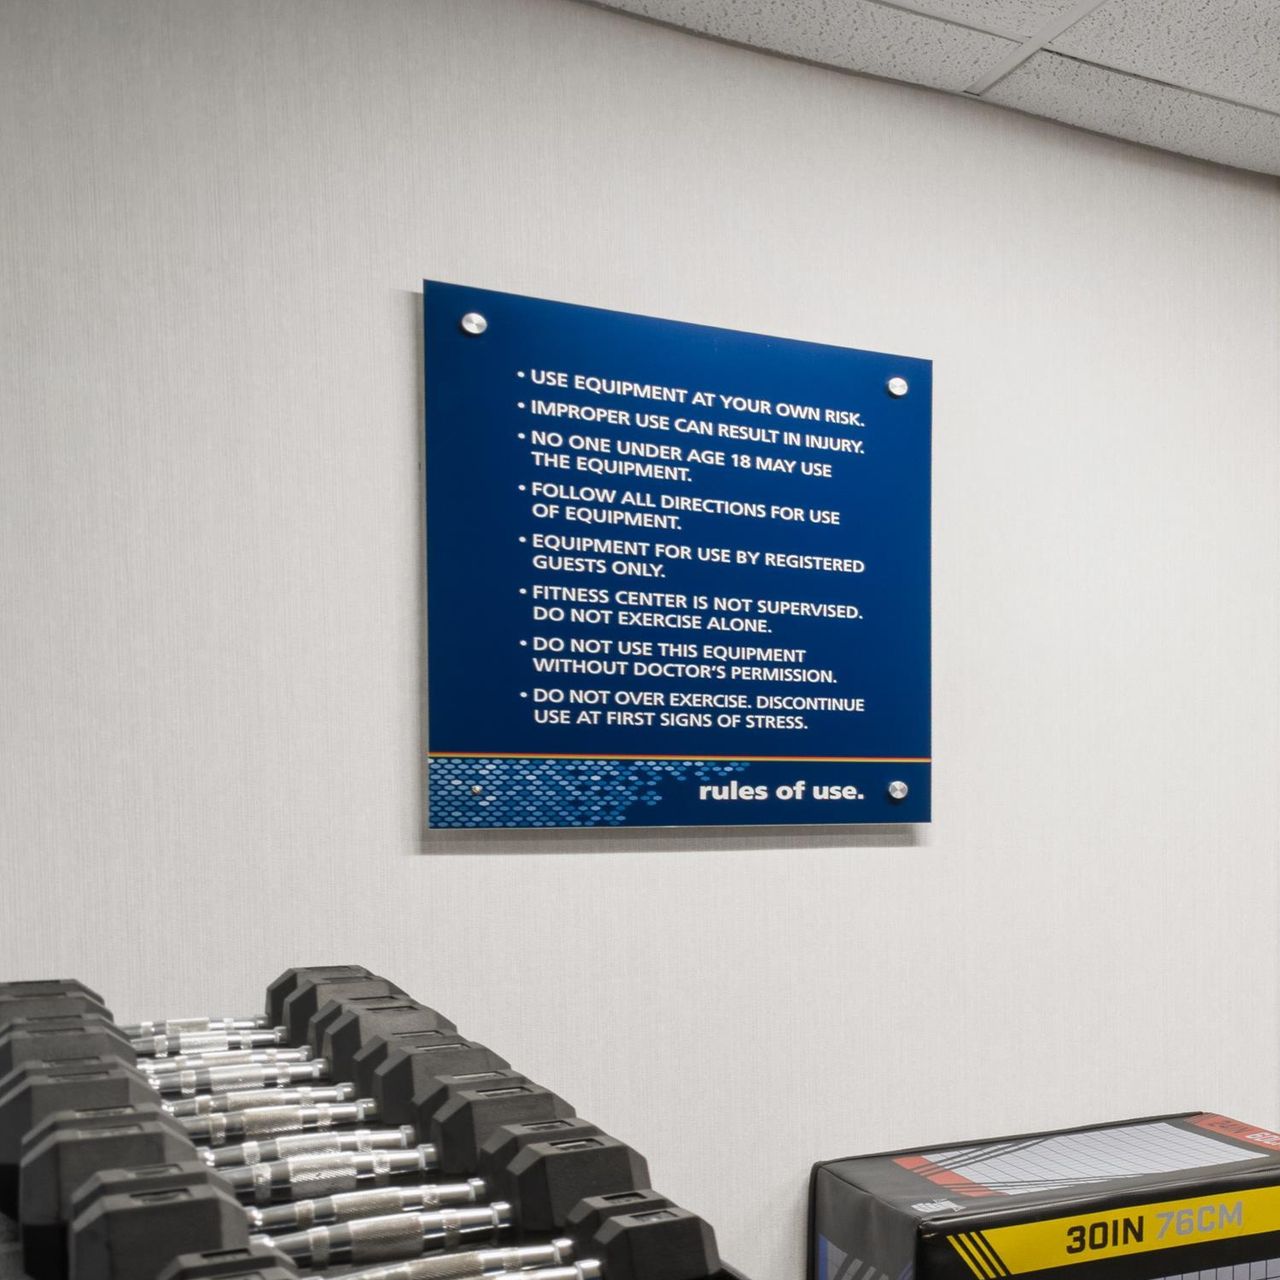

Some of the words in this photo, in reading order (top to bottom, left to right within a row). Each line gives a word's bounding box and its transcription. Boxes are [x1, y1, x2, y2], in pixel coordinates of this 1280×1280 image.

[530, 368, 568, 388] USE
[574, 374, 689, 403] EQUIPMENT
[691, 391, 717, 407] AT
[719, 394, 772, 415] YOUR
[775, 402, 821, 422] OWN
[824, 408, 865, 427] RISK.
[531, 399, 631, 426] IMPROPER
[635, 412, 670, 431] USE
[673, 418, 714, 436] CAN
[717, 423, 780, 444] RESULT
[783, 431, 801, 447] IN
[805, 434, 865, 454] INJURY.
[530, 451, 571, 470] THE
[576, 456, 692, 482] EQUIPMENT.
[531, 430, 564, 448] NO
[568, 434, 611, 453] ONE
[616, 440, 683, 461] UNDER
[686, 448, 725, 466] AGE
[731, 453, 752, 469] 18
[755, 456, 797, 474] MAY
[800, 461, 832, 478] USE
[531, 481, 617, 504] FOLLOW
[620, 491, 657, 508] ALL
[660, 494, 767, 518] DIRECTIONS
[770, 505, 805, 522] FOR
[809, 509, 840, 525] USE
[531, 503, 560, 519] OF
[565, 505, 682, 530] EQUIPMENT.
[532, 533, 651, 557] EQUIPMENT
[655, 543, 692, 560] FOR
[697, 547, 731, 563] USE
[736, 550, 761, 565] BY
[764, 552, 865, 573] REGISTERED
[532, 554, 607, 574] GUESTS
[611, 560, 666, 578] ONLY.
[532, 584, 610, 604] FITNESS
[614, 590, 688, 609] CENTER
[693, 595, 709, 610] IS
[713, 596, 753, 613] NOT
[757, 599, 863, 620] SUPERVISED.
[533, 606, 565, 622] DO
[570, 608, 614, 624] NOT
[618, 611, 702, 630] EXERCISE
[706, 616, 772, 633] ALONE.
[533, 636, 565, 652] DO
[570, 638, 613, 654] NOT
[618, 640, 653, 656] USE
[657, 642, 698, 658] THIS
[703, 644, 807, 663] EQUIPMENT
[532, 657, 629, 676] WITHOUT
[731, 665, 837, 684] PERMISSION.
[533, 688, 565, 703] DO
[569, 689, 611, 705] NOT
[614, 690, 665, 706] OVER
[669, 692, 752, 709] EXERCISE.
[756, 695, 865, 712] DISCONTINUE
[534, 709, 571, 724] USE
[575, 710, 602, 725] AT
[606, 711, 656, 726] FIRST
[660, 712, 713, 728] SIGNS
[716, 714, 741, 728] OF
[745, 714, 808, 730] STRESS.
[699, 780, 768, 800] rules
[776, 780, 805, 800] of
[812, 785, 865, 800] use.
[1066, 1215, 1144, 1254] 30IN
[1155, 1200, 1243, 1241] 76CM
